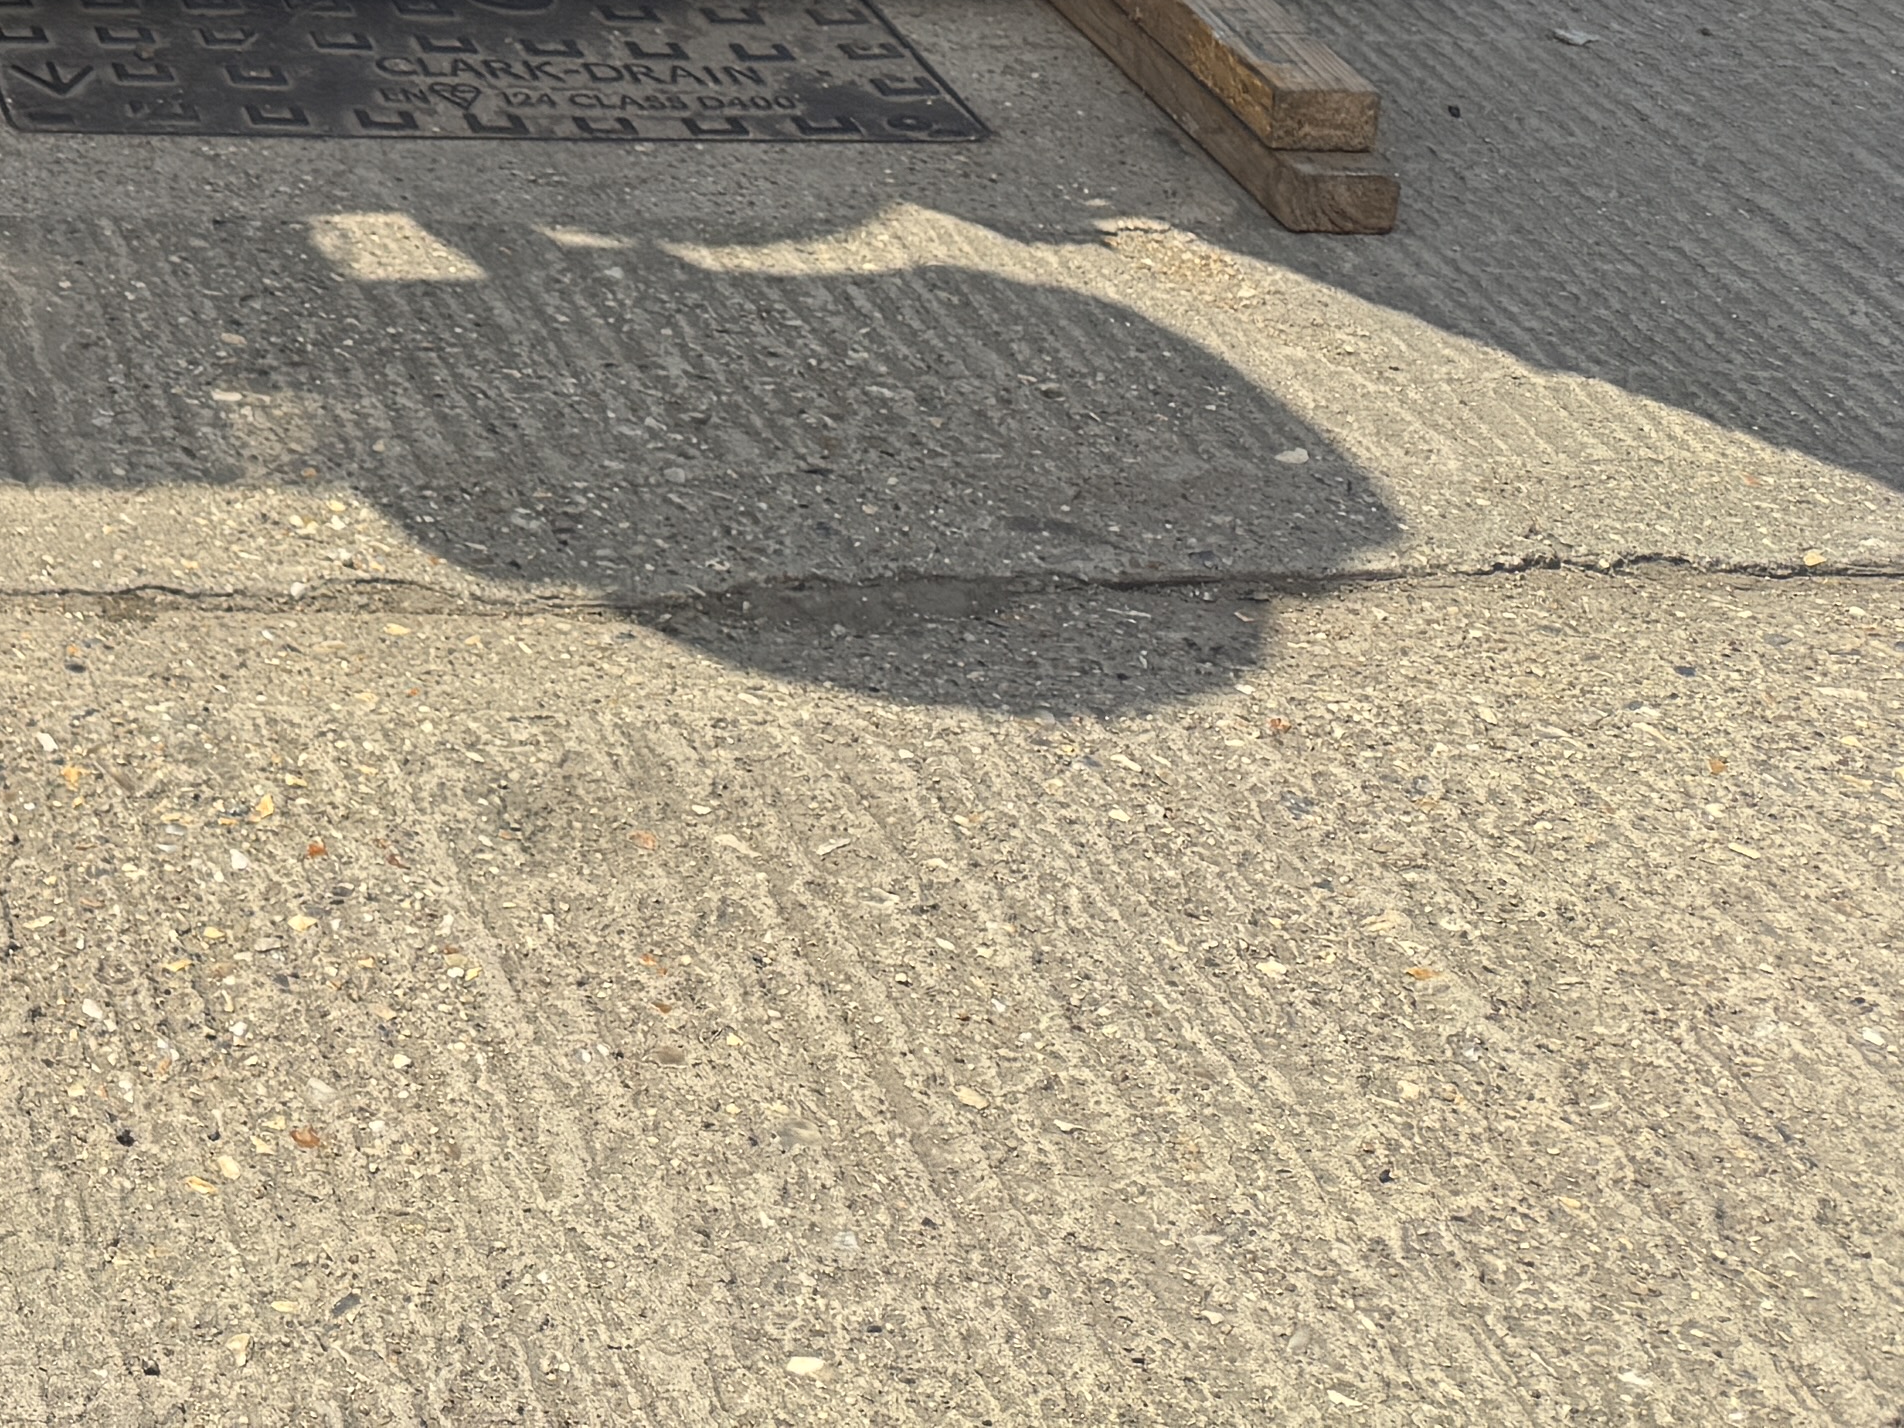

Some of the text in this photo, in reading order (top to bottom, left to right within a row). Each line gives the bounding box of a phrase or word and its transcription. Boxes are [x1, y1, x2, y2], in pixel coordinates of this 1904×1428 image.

[374, 56, 767, 86] CLARK-DRAIN
[501, 91, 557, 108] 124
[569, 93, 688, 111] CLASS
[697, 95, 793, 111] D400
